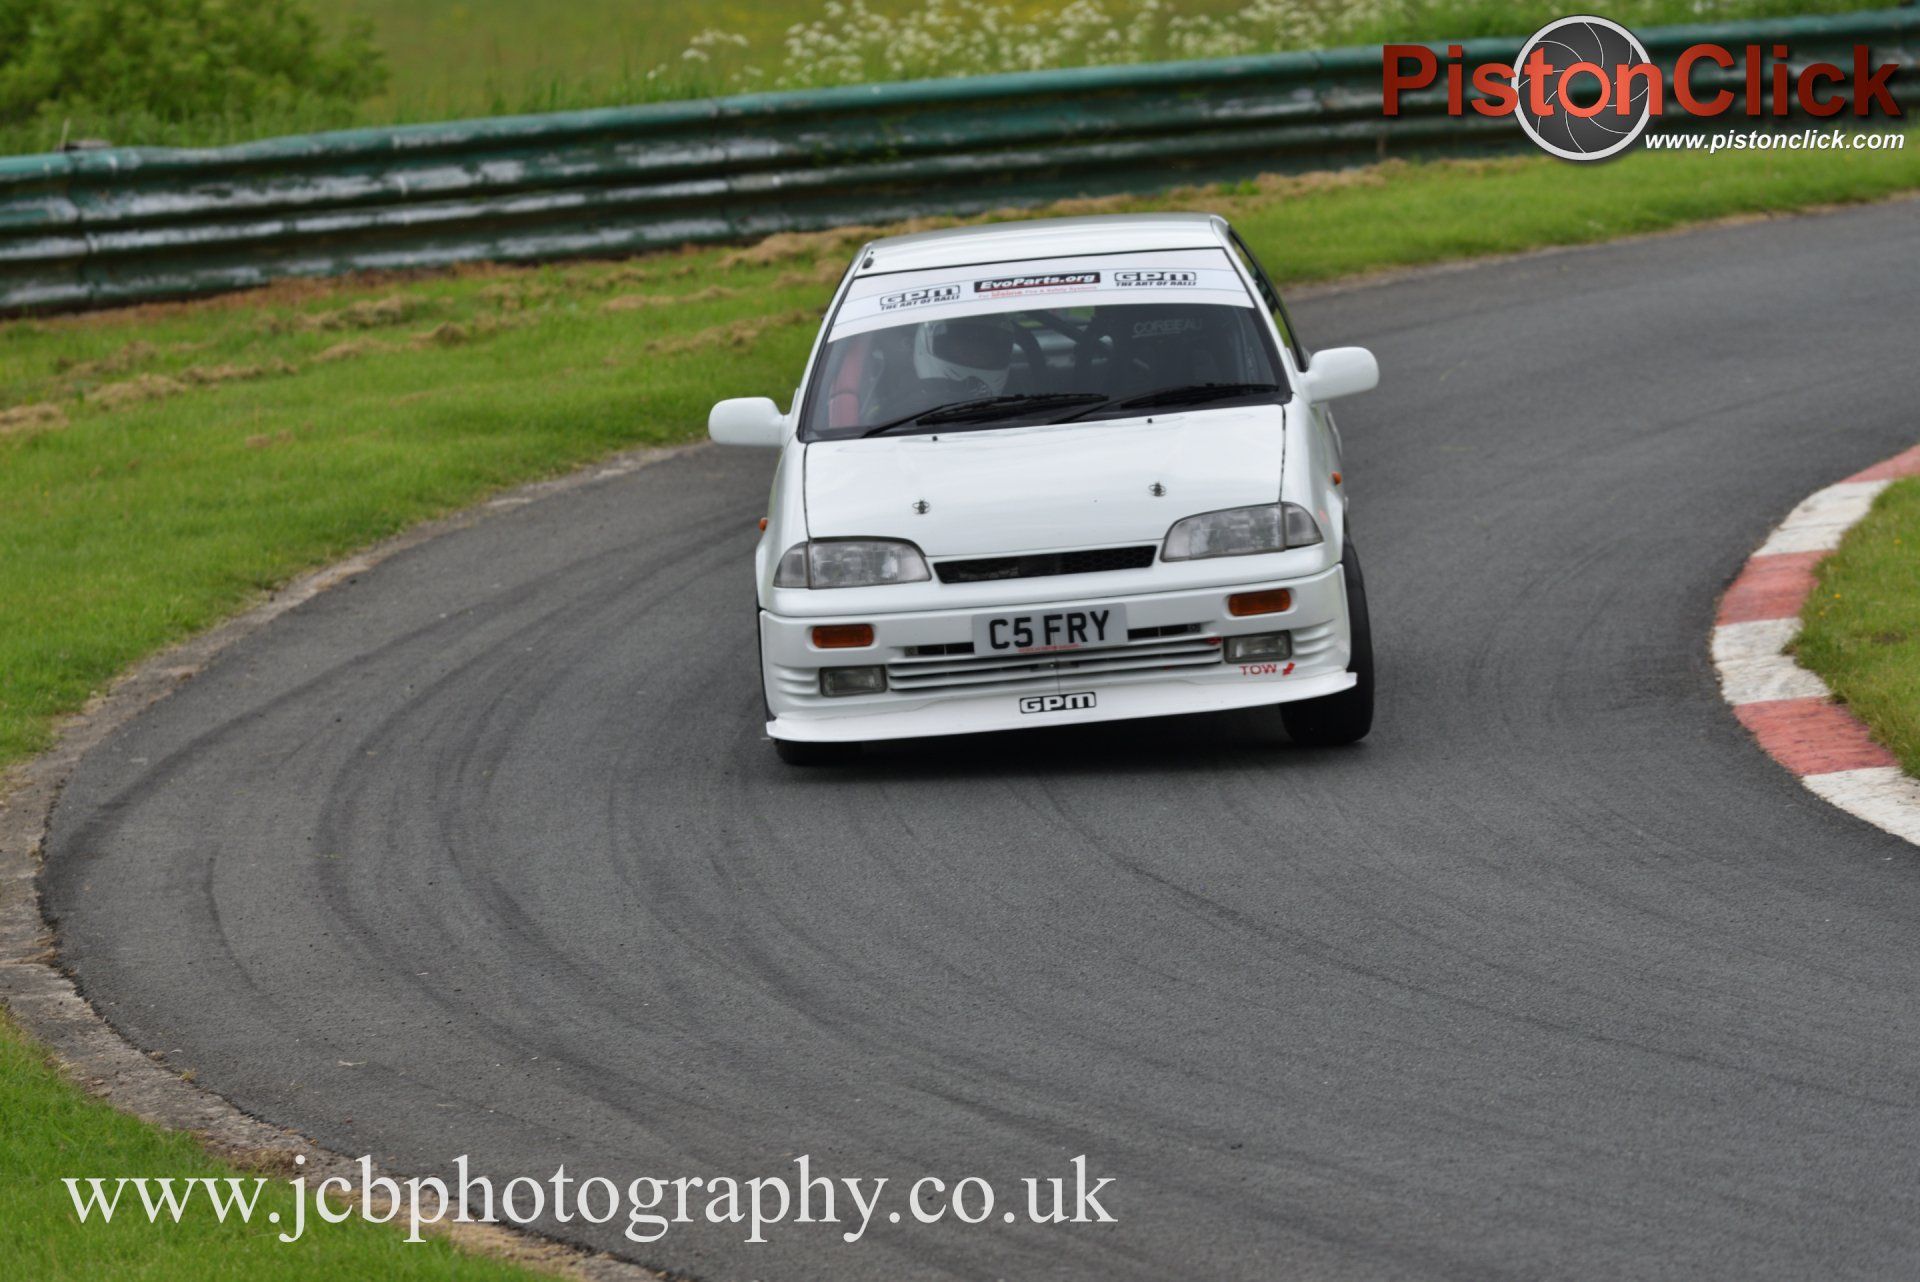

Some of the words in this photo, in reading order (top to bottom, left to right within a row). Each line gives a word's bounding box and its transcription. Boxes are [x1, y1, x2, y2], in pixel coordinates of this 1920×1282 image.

[980, 275, 1095, 289] EvoParts.org
[989, 617, 1033, 649] C5
[1043, 610, 1109, 645] FRY
[1239, 664, 1277, 675] TOW
